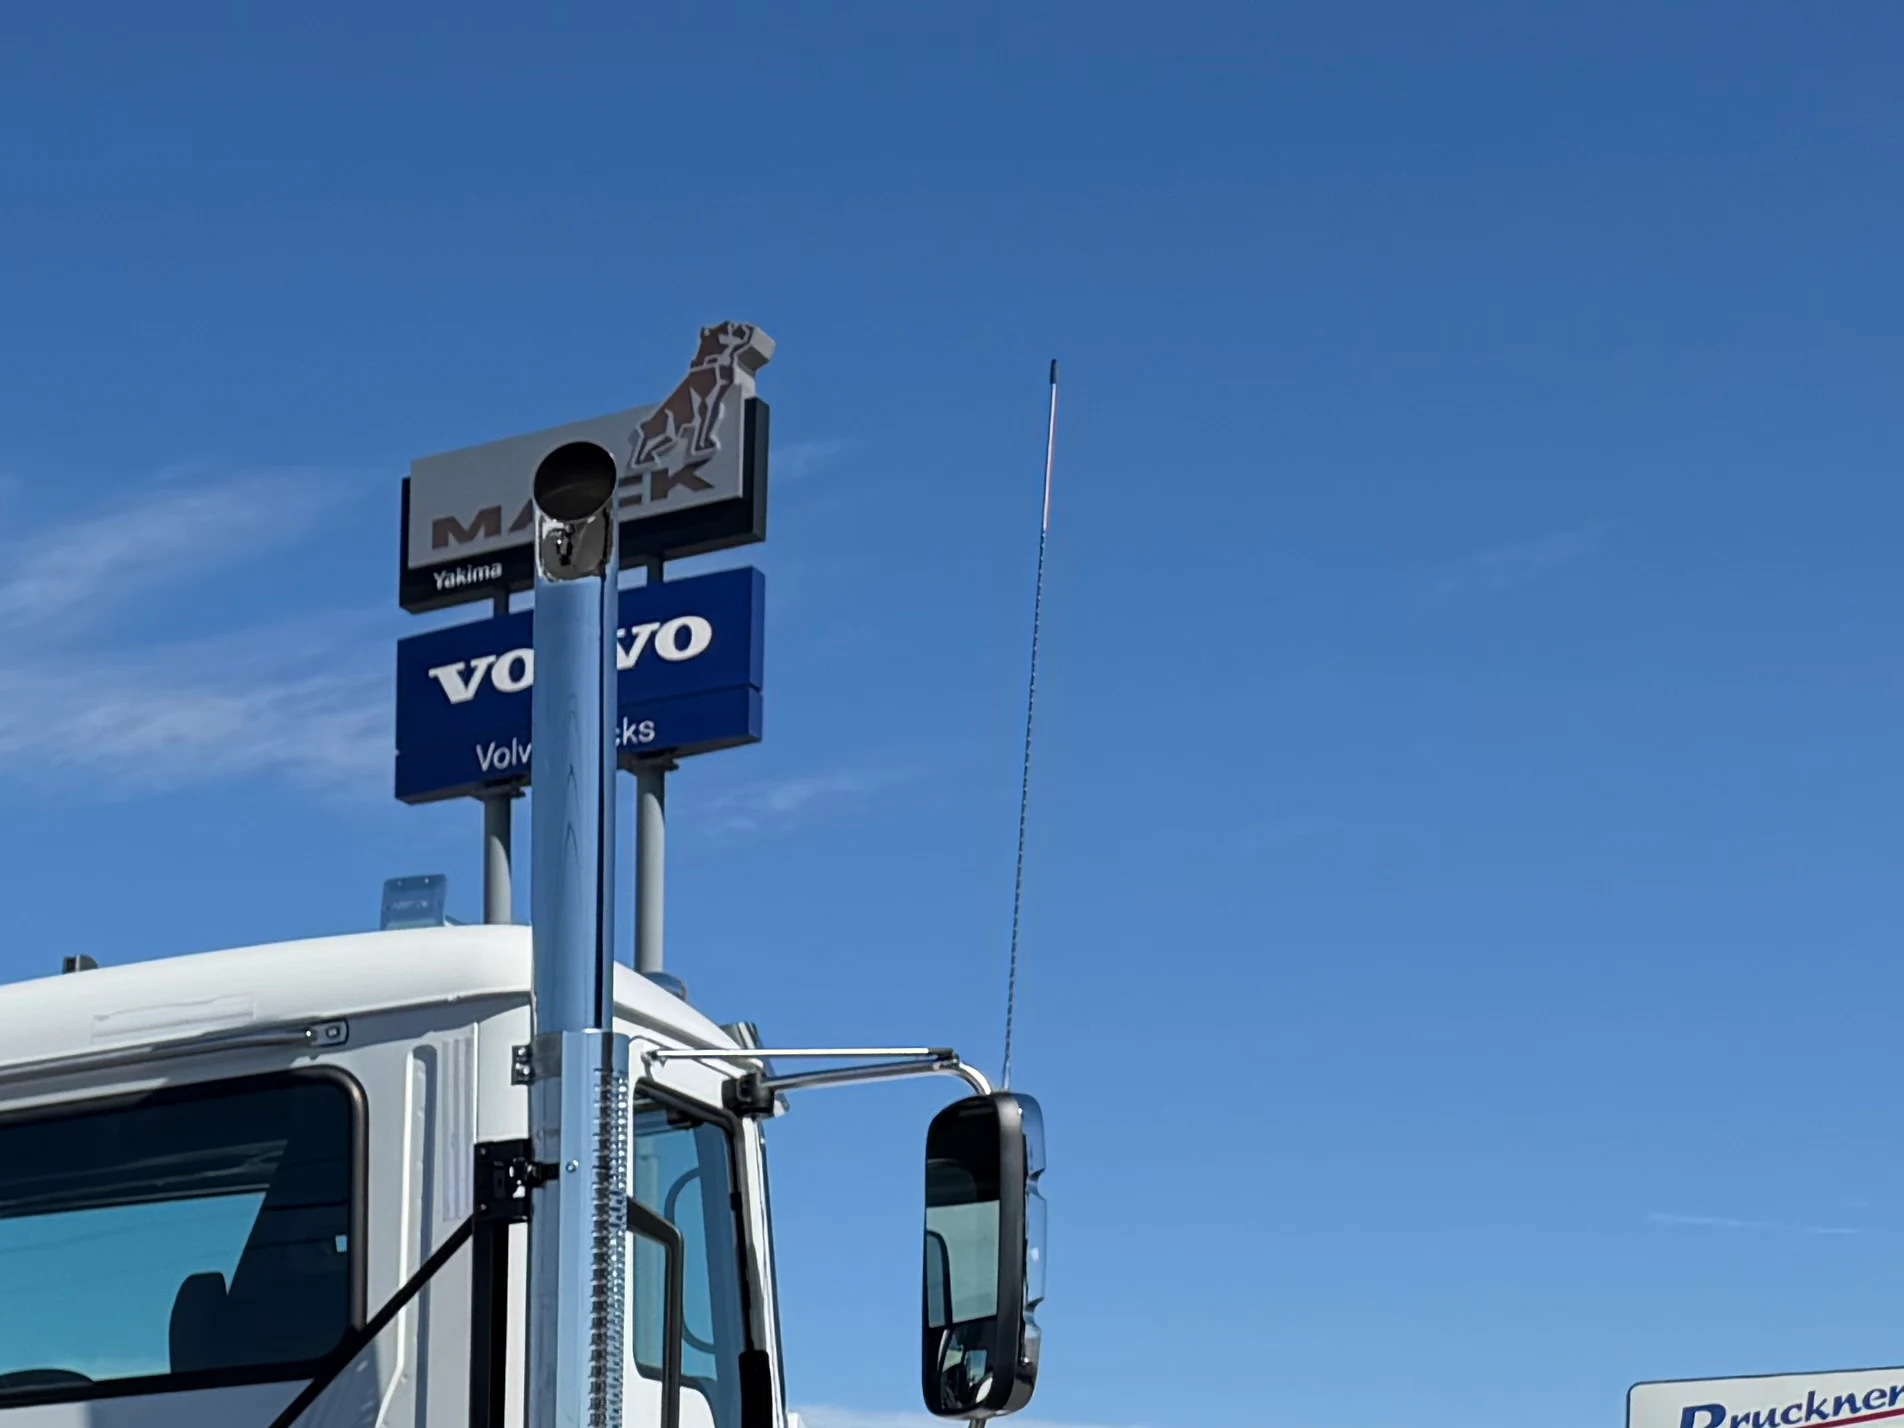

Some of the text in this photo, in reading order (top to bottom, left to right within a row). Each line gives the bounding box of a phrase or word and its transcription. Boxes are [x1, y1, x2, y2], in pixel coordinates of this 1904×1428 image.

[431, 462, 715, 550] MK
[433, 563, 502, 590] Yakima
[428, 614, 713, 704] VOVO
[476, 736, 533, 772] Volv
